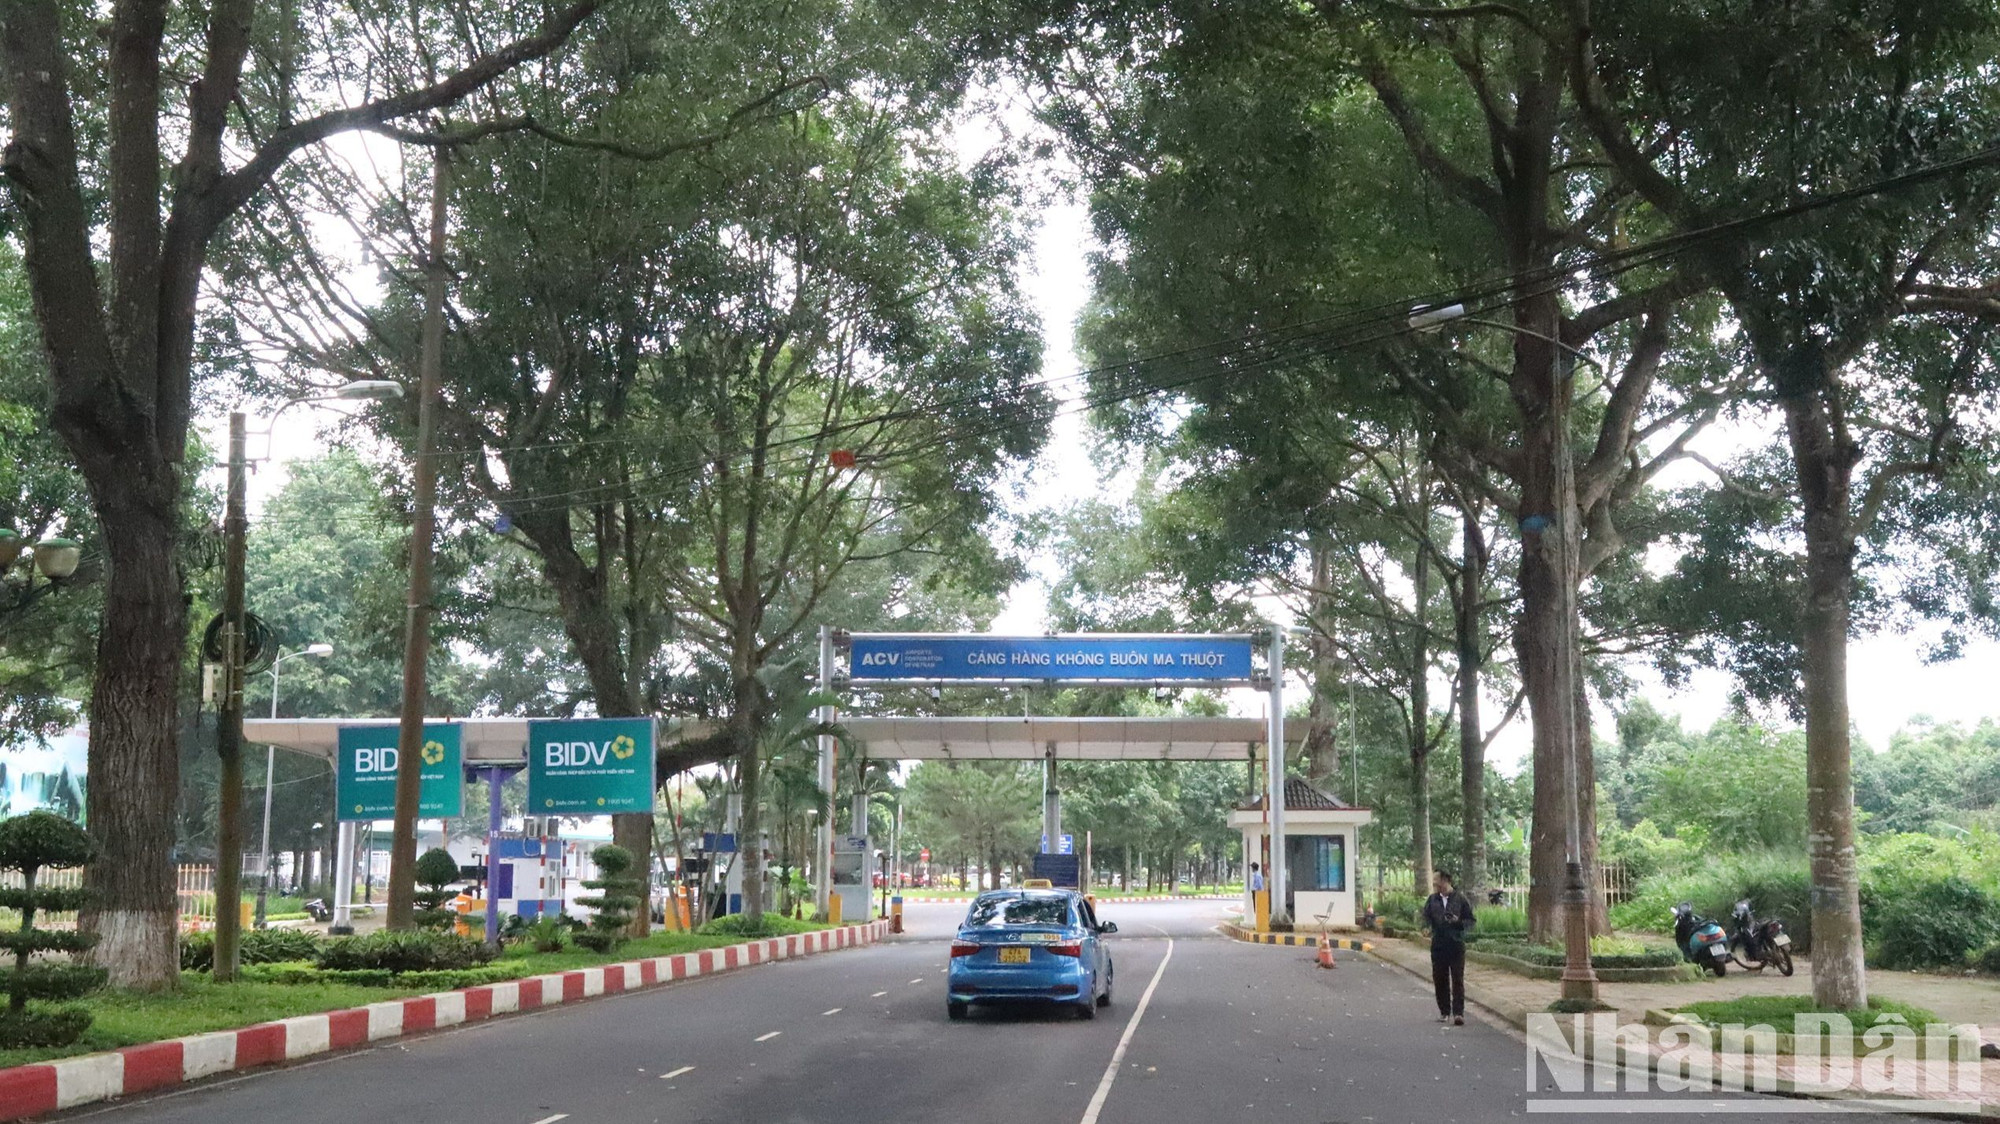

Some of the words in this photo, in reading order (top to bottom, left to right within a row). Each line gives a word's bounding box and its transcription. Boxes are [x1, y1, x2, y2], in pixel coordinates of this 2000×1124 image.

[862, 652, 899, 665] ACV
[967, 650, 1006, 665] CẢNG
[1011, 650, 1050, 665] HÀNG
[1056, 650, 1104, 665] KHÔNG
[1110, 650, 1148, 665] BUÔN
[1153, 653, 1175, 665] MA
[1180, 651, 1225, 668] THUỘT
[355, 748, 398, 772] BID
[546, 741, 611, 766] BIDV
